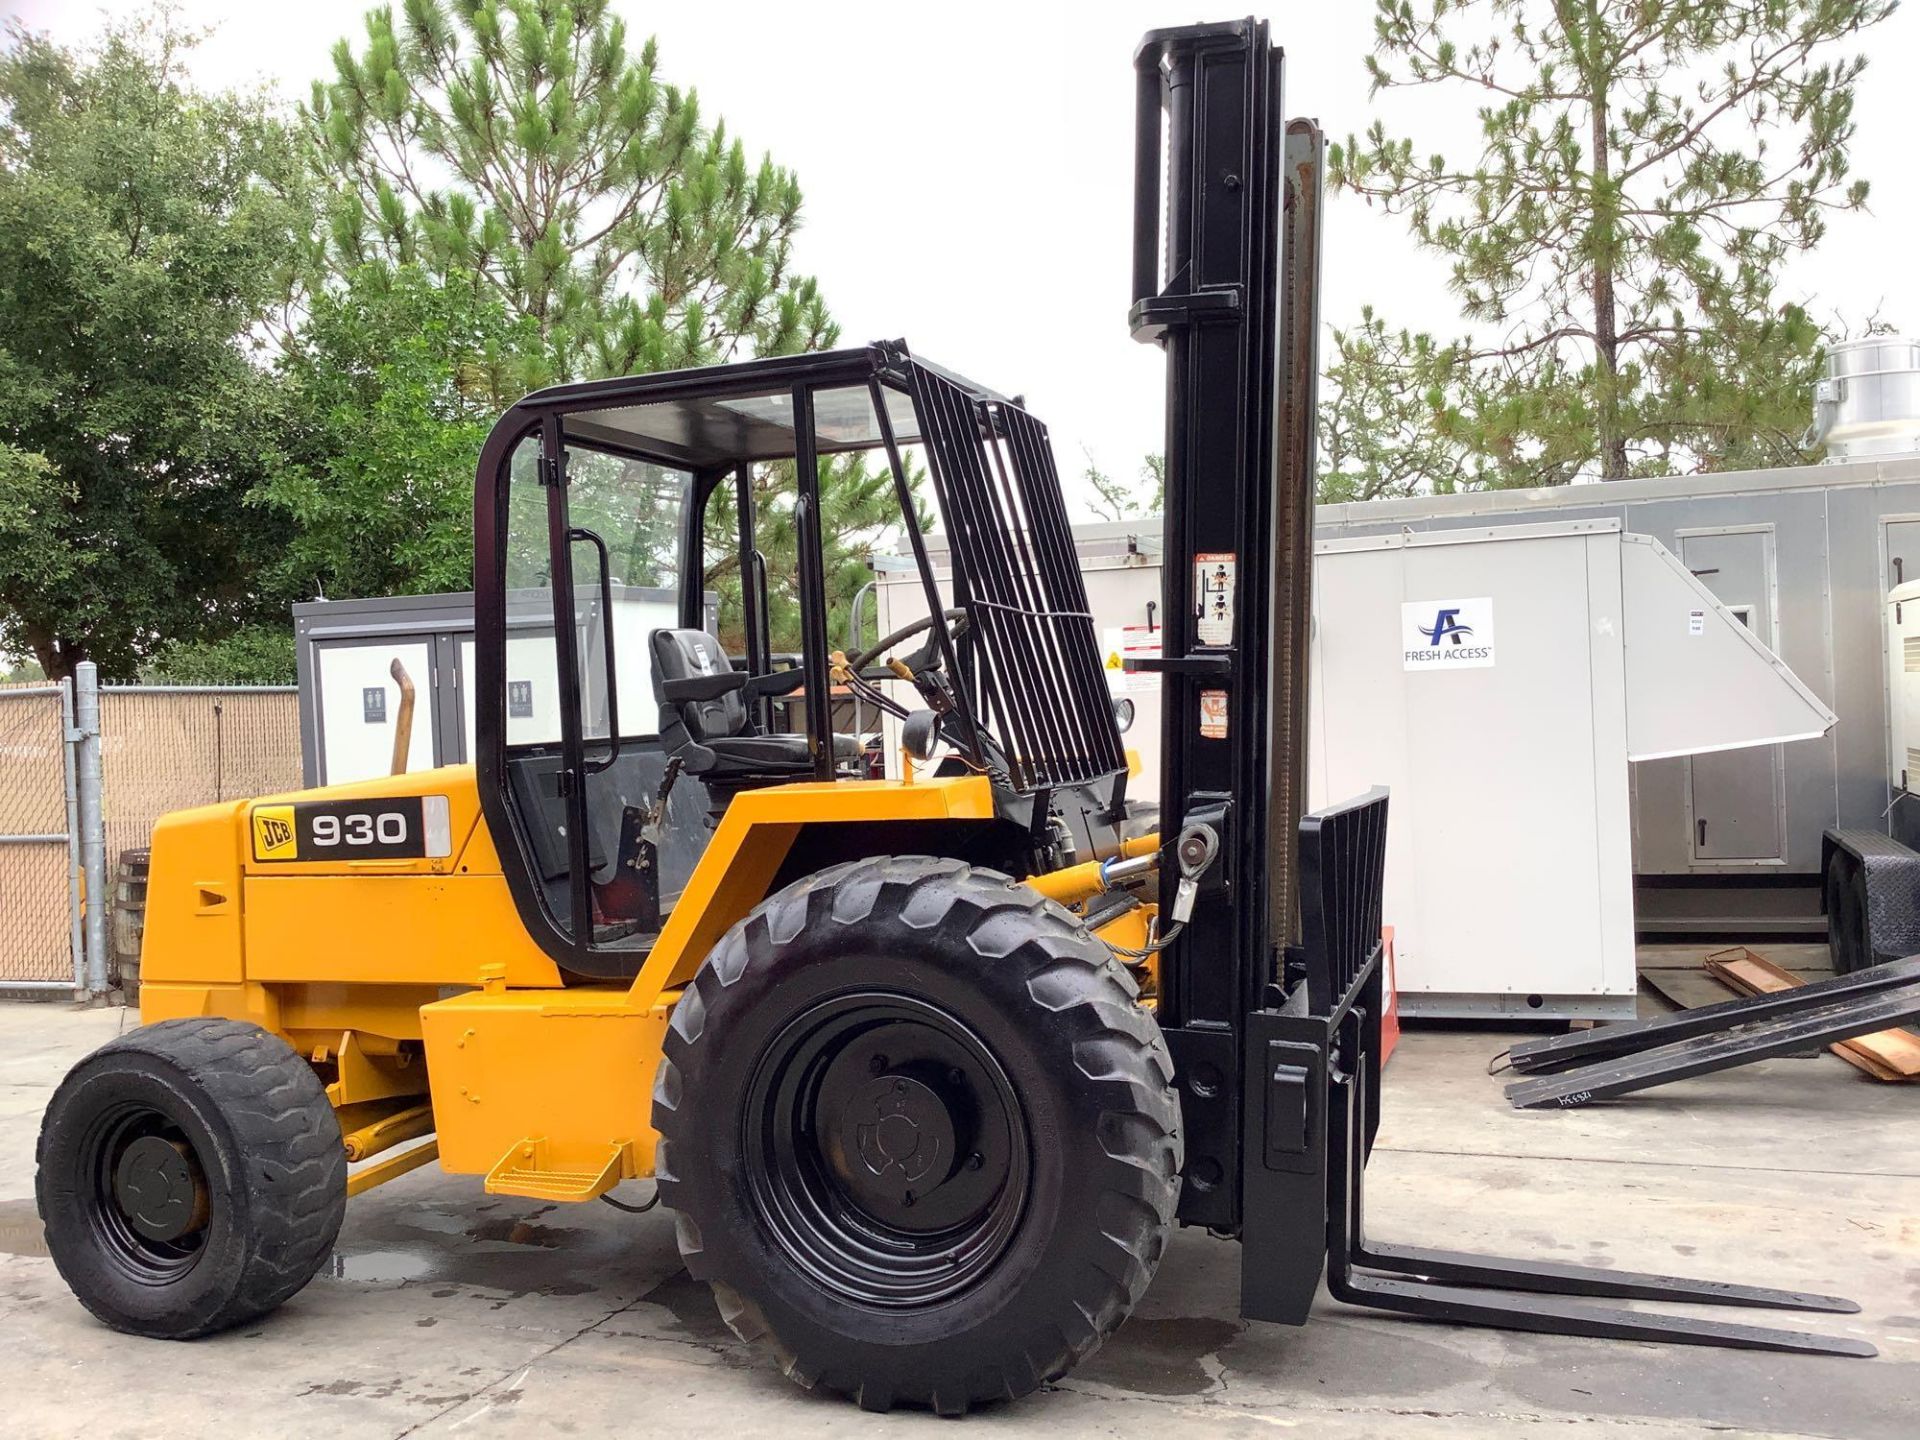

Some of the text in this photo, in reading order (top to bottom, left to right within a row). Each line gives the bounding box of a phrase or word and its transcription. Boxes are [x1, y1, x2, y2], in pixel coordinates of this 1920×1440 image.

[1405, 650, 1440, 661] FRESH
[263, 819, 291, 848] JCB
[312, 813, 407, 846] 930
